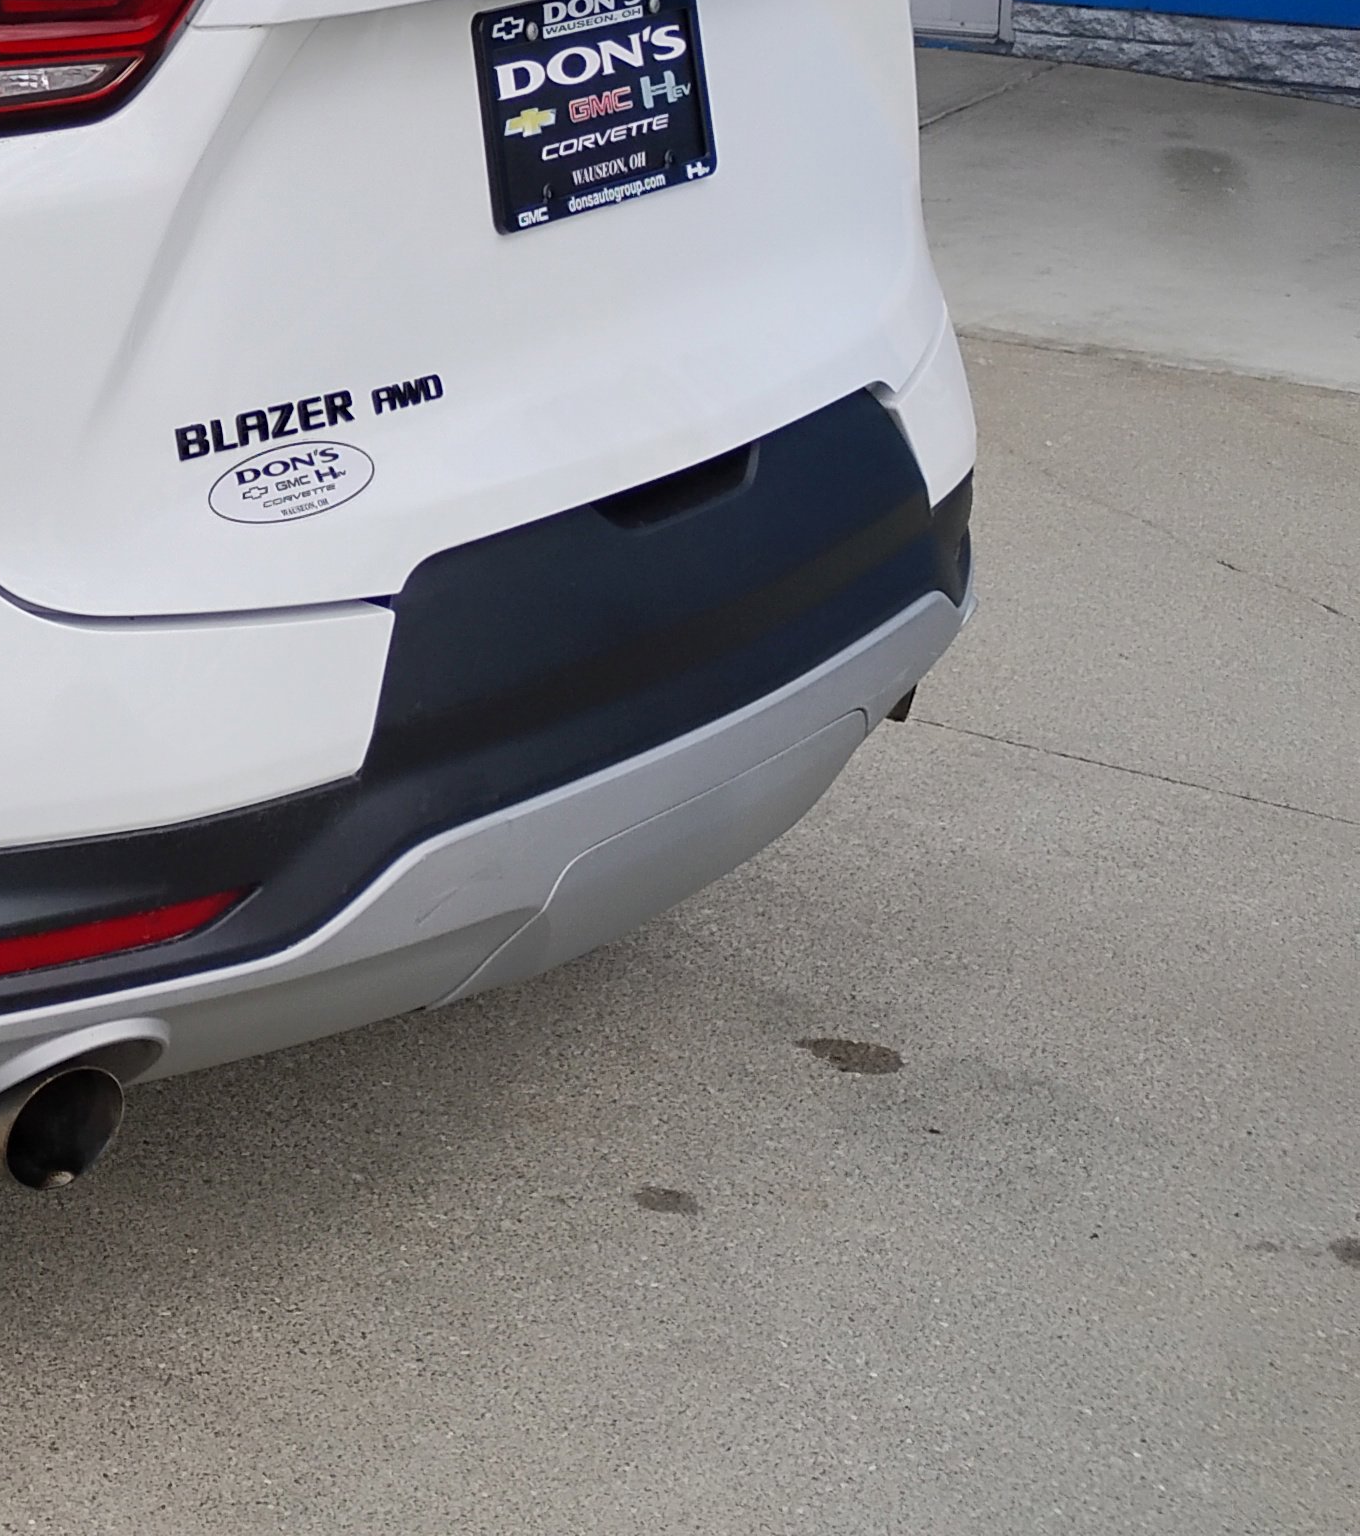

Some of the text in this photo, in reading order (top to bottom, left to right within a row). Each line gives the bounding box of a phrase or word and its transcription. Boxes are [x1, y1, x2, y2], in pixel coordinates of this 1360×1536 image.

[544, 7, 641, 36] WAUSEON, OH
[494, 24, 687, 101] DON'S
[569, 86, 634, 123] GMC
[542, 113, 670, 161] CORVETTE
[630, 151, 647, 169] OH
[568, 173, 667, 213] donsautogroup.com
[518, 206, 550, 227] GMC
[174, 373, 444, 462] BLAZER AWD
[235, 447, 340, 486] DON'S
[275, 474, 311, 491] GMC
[262, 483, 337, 508] CORVETTE
